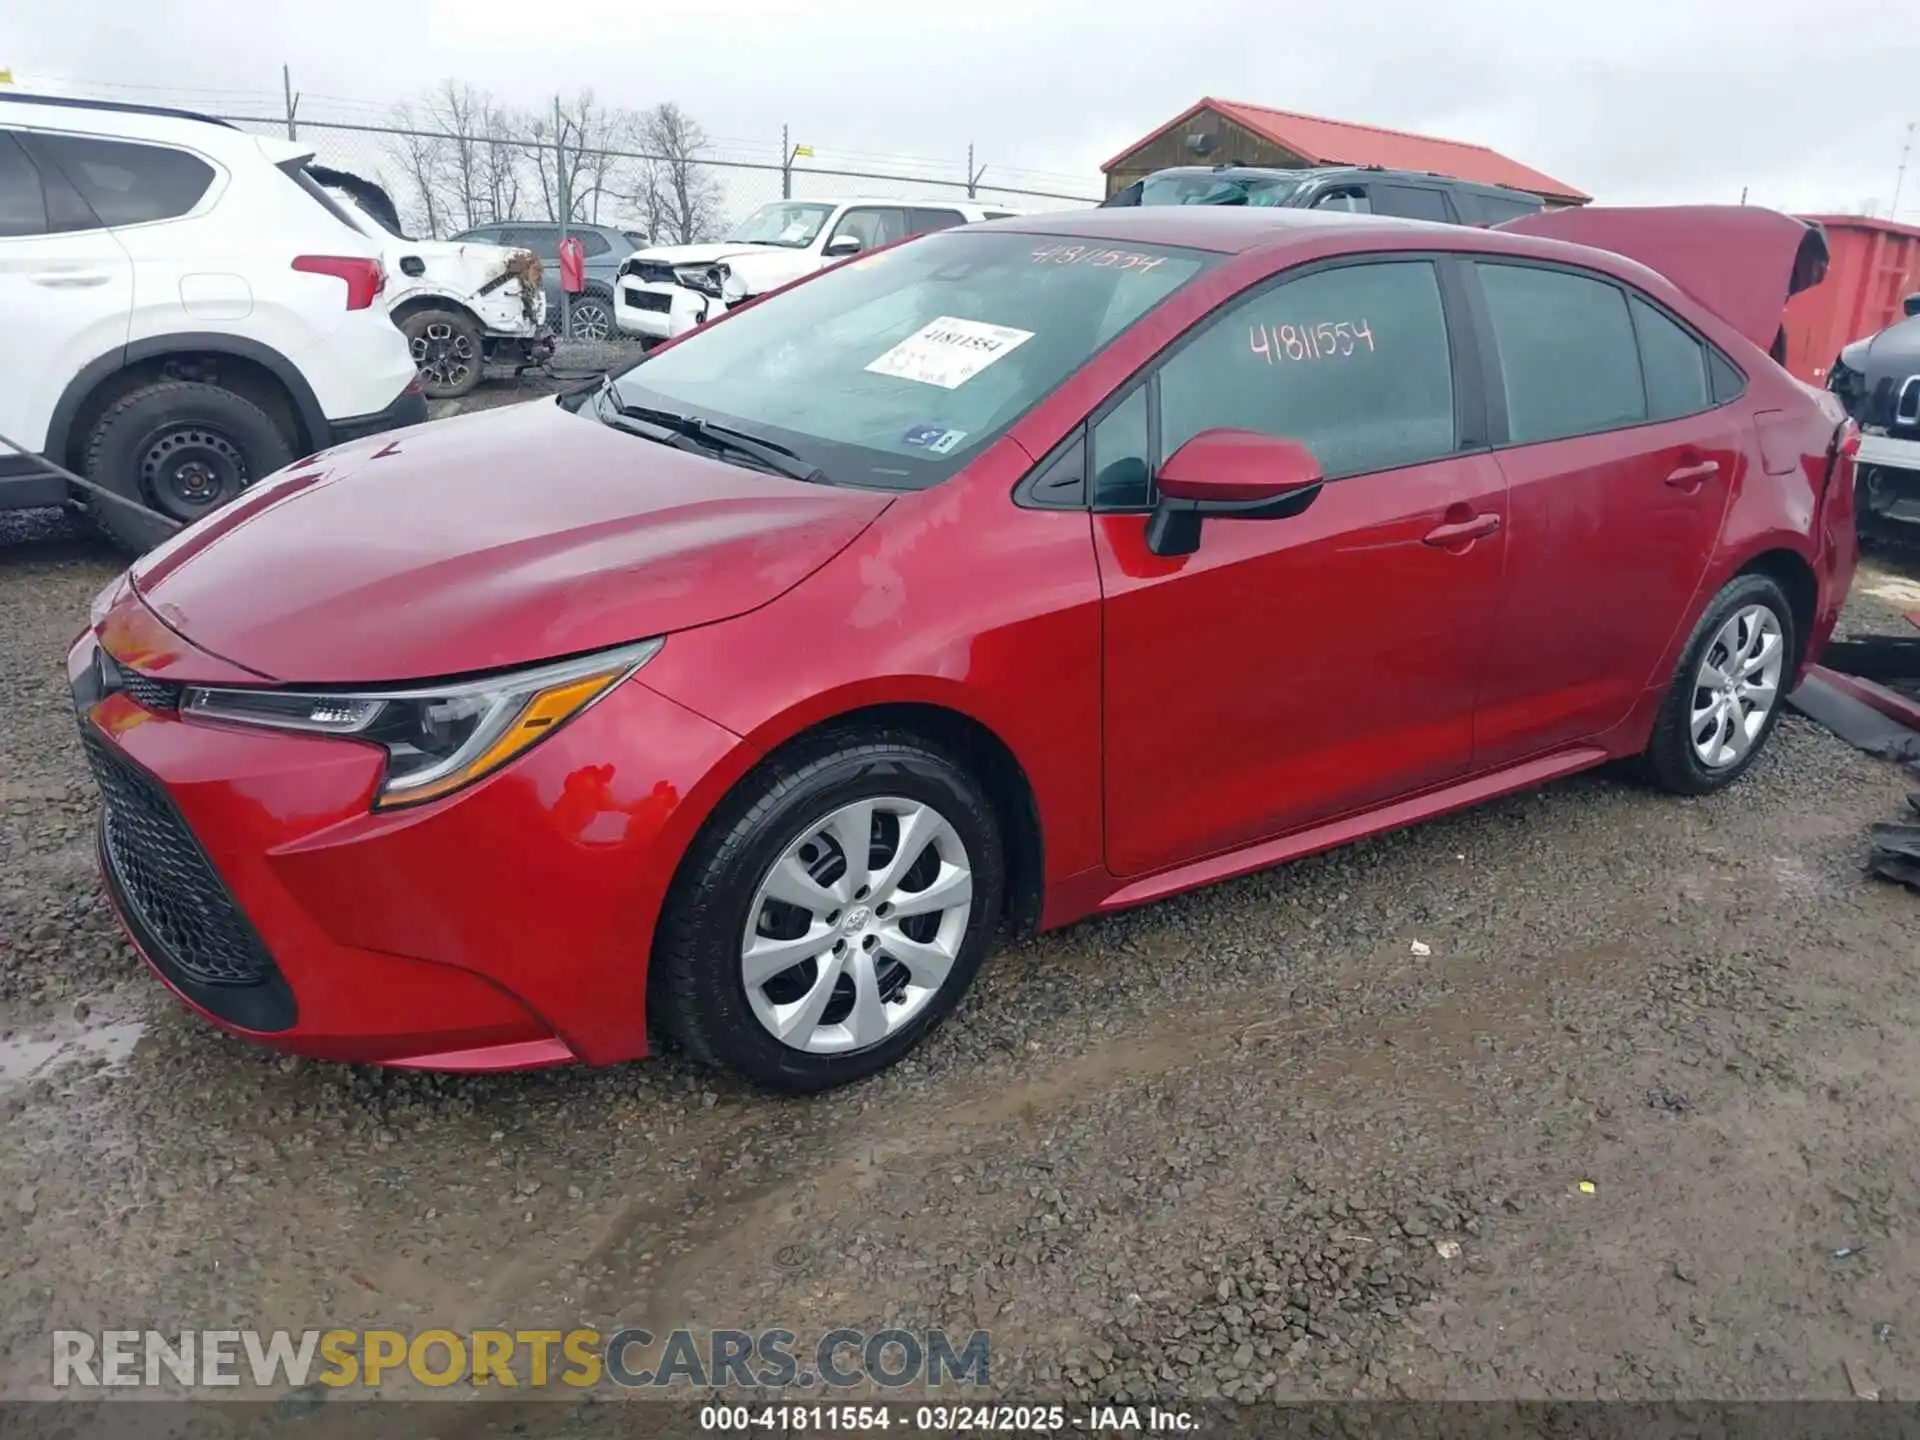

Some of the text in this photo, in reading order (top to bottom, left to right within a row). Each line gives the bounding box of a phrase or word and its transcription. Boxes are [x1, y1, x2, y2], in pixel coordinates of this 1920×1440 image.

[1031, 243, 1168, 274] 41811554
[924, 329, 1004, 352] 41811554
[1250, 318, 1374, 365] 41811554
